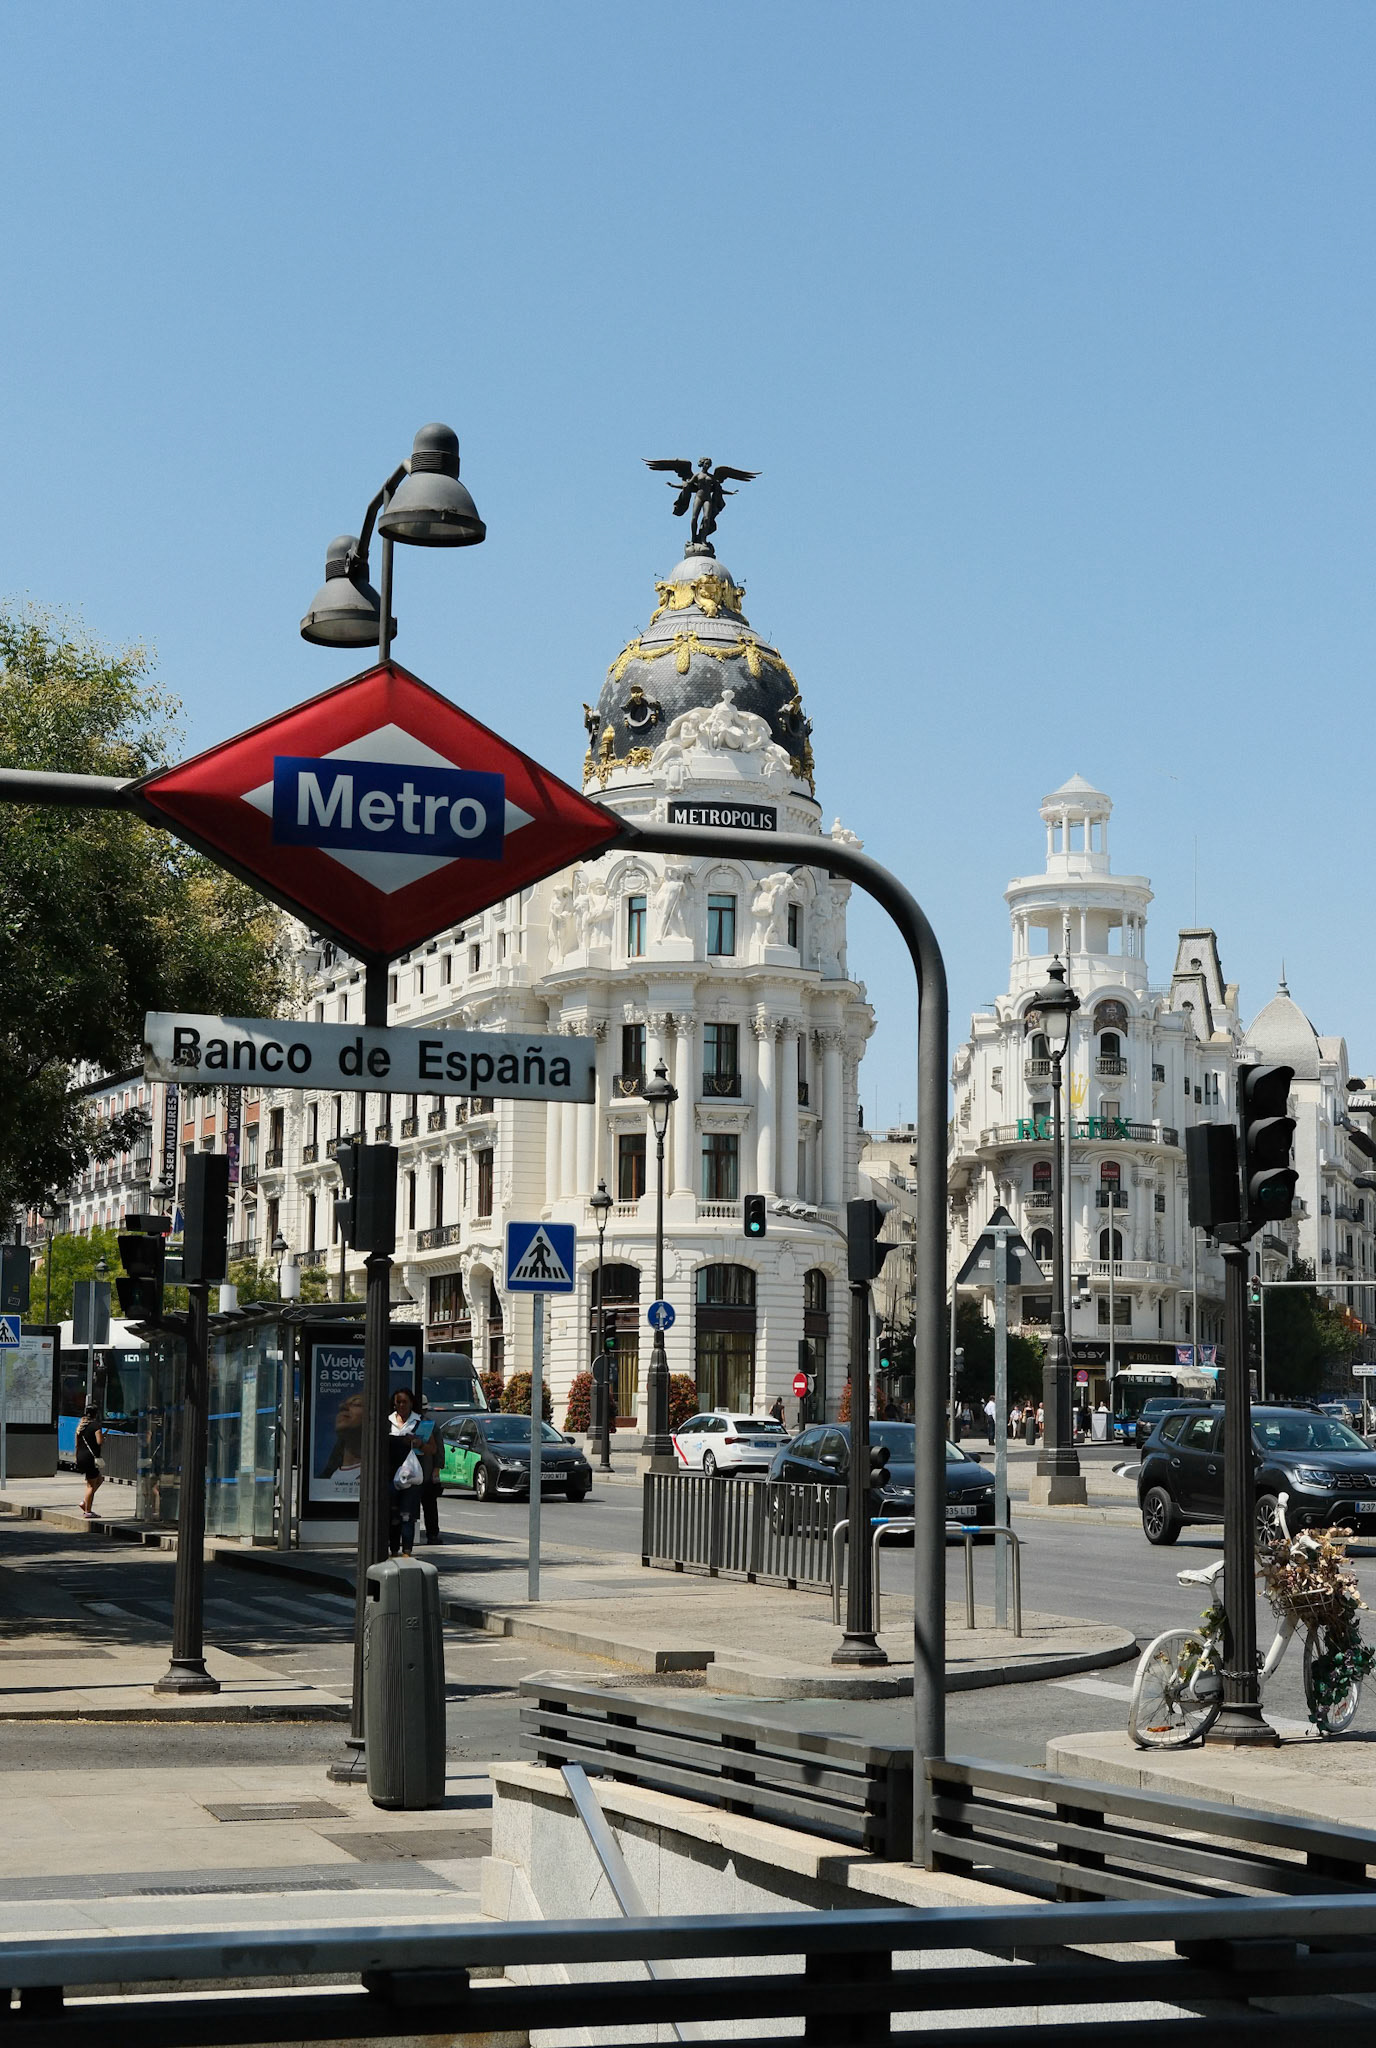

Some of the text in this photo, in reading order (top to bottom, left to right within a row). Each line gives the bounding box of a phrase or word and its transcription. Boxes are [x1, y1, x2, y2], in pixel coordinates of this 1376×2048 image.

[297, 771, 487, 839] Metro
[673, 808, 773, 830] METROPOLIS
[172, 1026, 571, 1091] Banco de España
[165, 1097, 177, 1188] OR SER MUJERES
[320, 1369, 329, 1380] a
[319, 1386, 342, 1394] Europa
[960, 1506, 975, 1515] LTB
